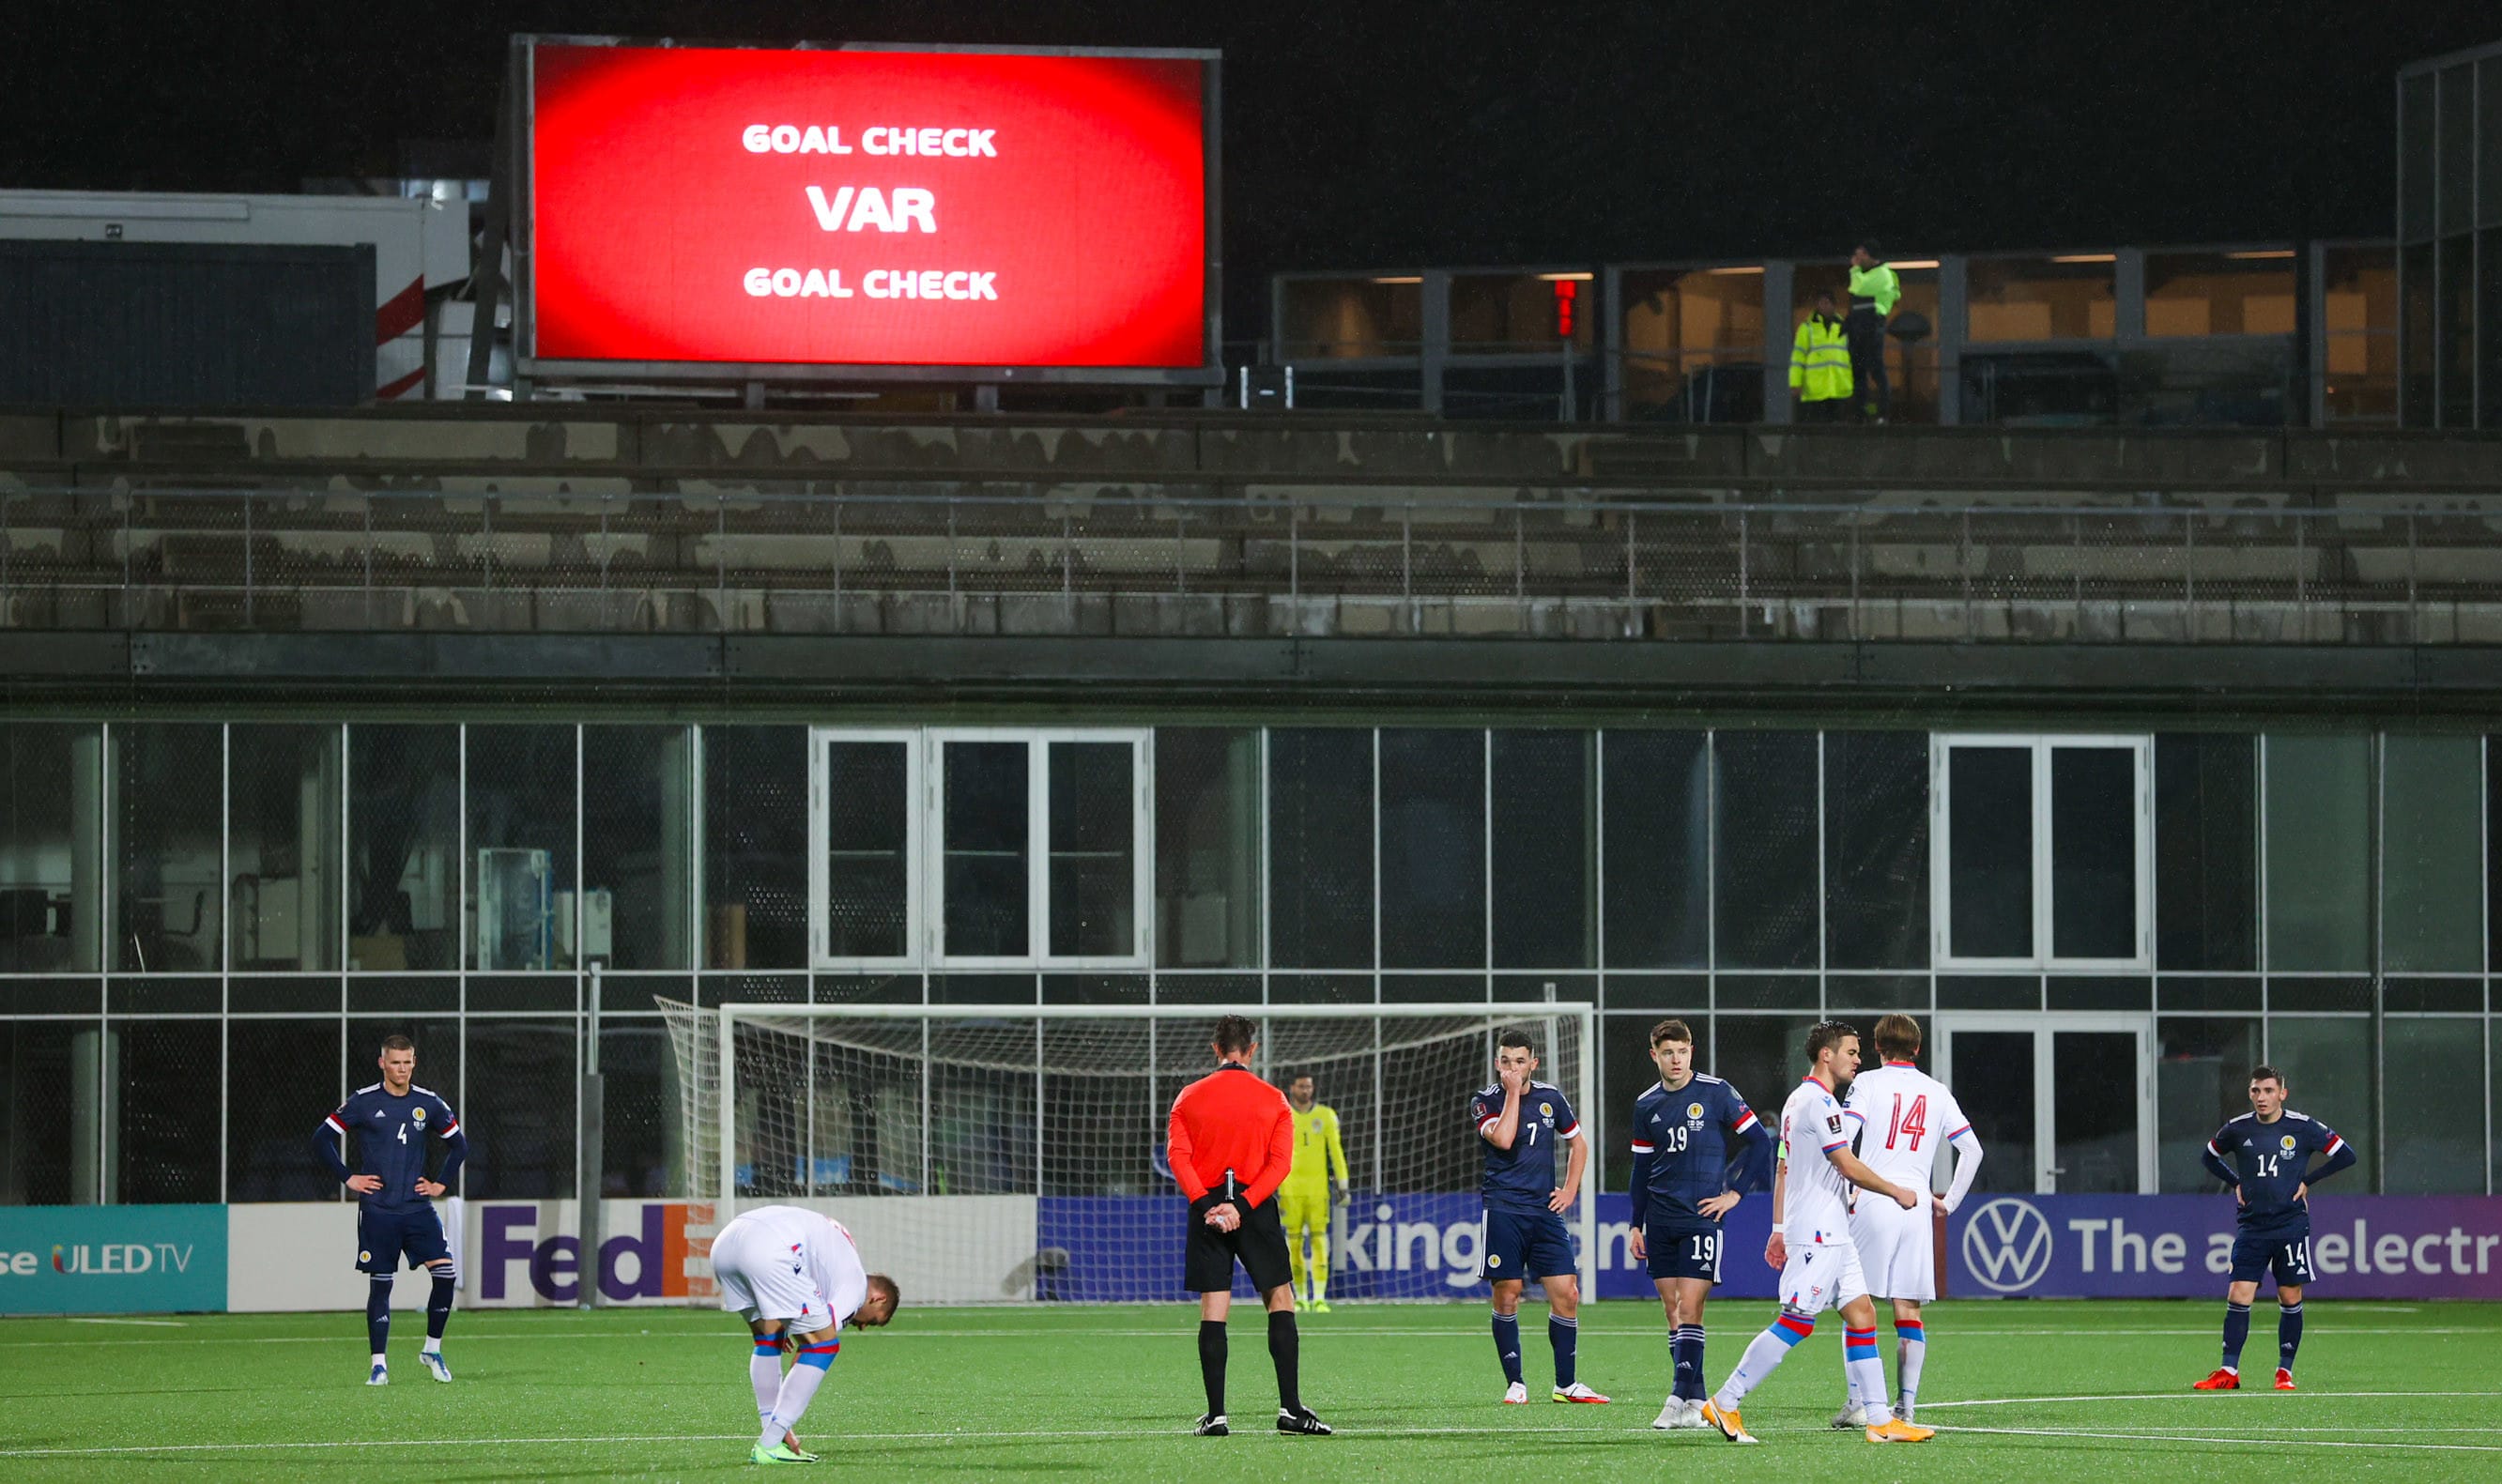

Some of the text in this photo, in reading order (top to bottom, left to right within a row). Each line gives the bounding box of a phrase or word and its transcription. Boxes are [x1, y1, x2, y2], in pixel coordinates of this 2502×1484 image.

[743, 124, 997, 158] GOAL CHECK
[806, 185, 937, 234] VAR
[743, 267, 998, 300] GOAL CHECK
[396, 1123, 407, 1145] 4
[1527, 1122, 1538, 1146] 7
[1885, 1093, 1926, 1152] 14
[1302, 1132, 1311, 1148] 1
[1666, 1125, 1688, 1153] 19
[2257, 1154, 2279, 1177] 14
[1288, 1204, 1481, 1288] king
[1691, 1234, 1714, 1261] 19
[2069, 1217, 2187, 1274] The
[2284, 1241, 2306, 1266] 14
